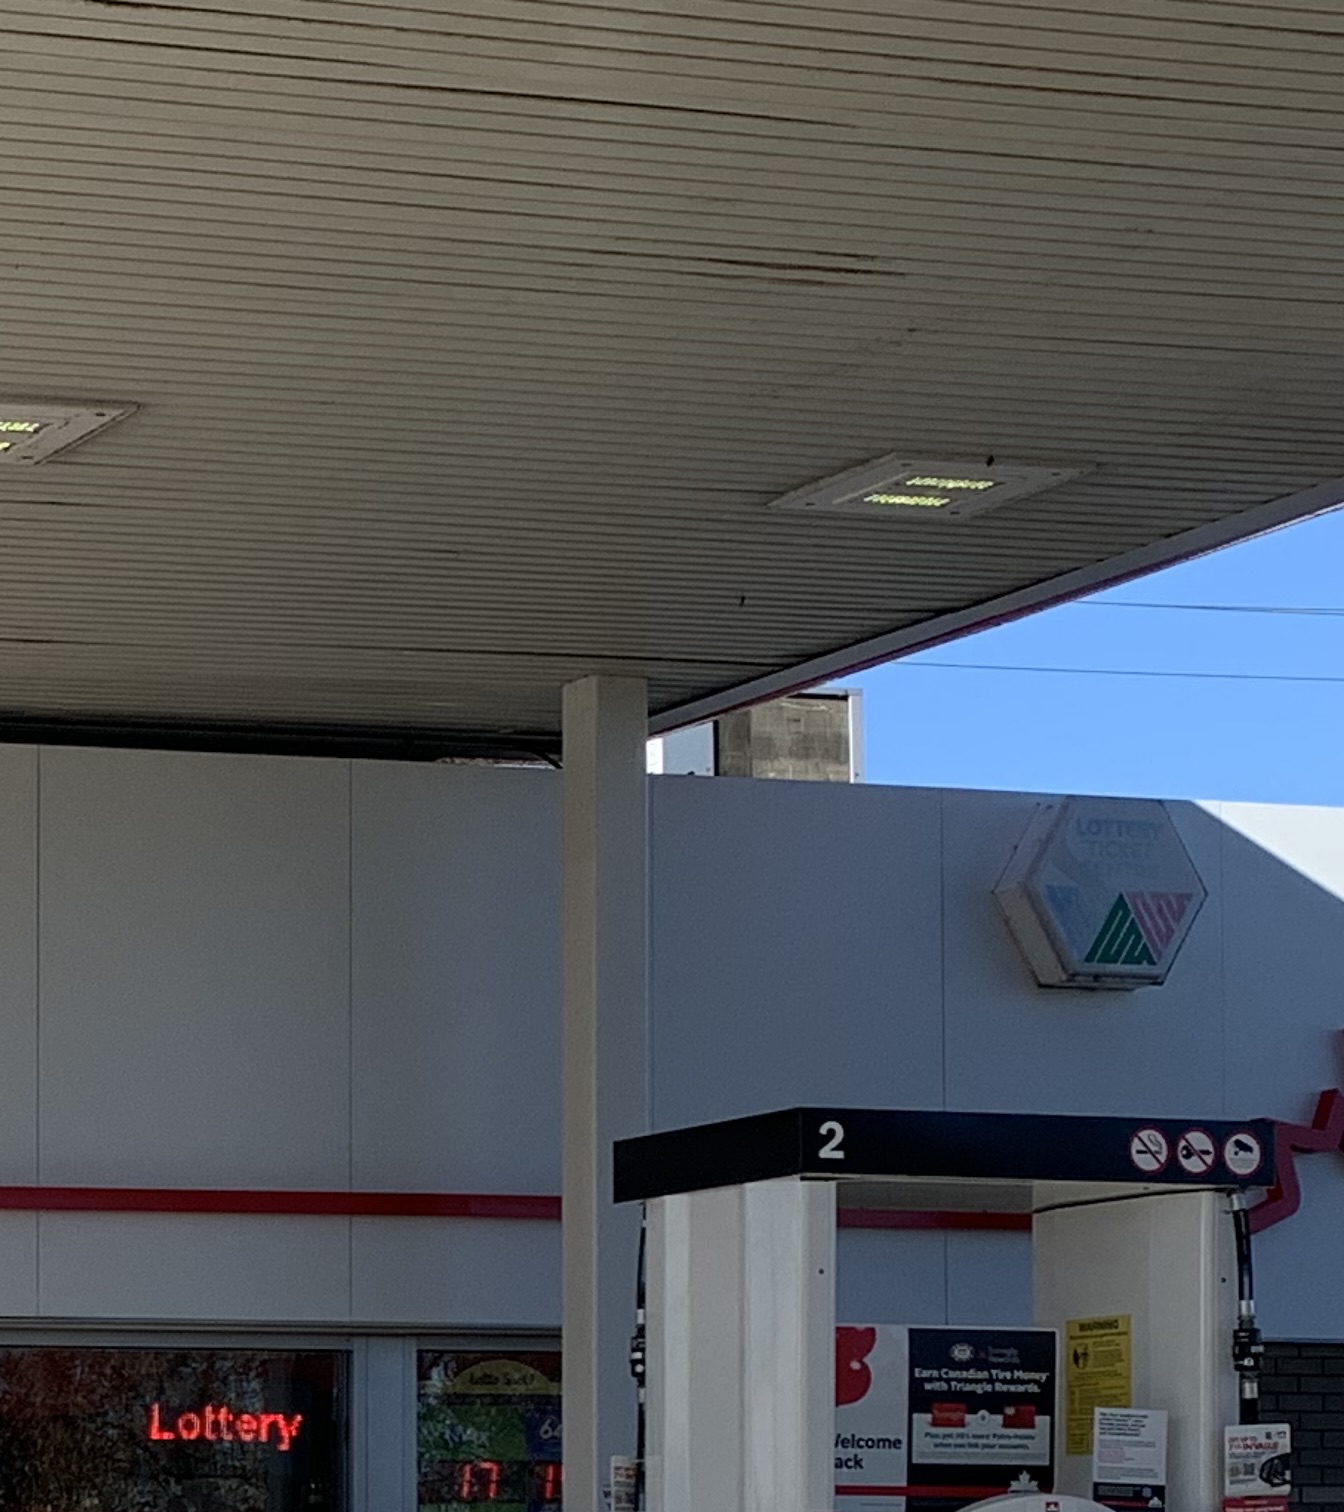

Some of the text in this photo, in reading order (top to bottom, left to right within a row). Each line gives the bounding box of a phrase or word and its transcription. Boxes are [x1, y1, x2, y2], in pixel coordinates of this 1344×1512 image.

[818, 1120, 845, 1159] 2
[914, 1367, 939, 1379] Earn
[940, 1368, 989, 1380] Canadian
[990, 1368, 1012, 1380] Tire
[923, 1380, 1041, 1394] with Triangle Rewards.
[148, 1402, 303, 1452] Lottery
[834, 1454, 864, 1470] ack
